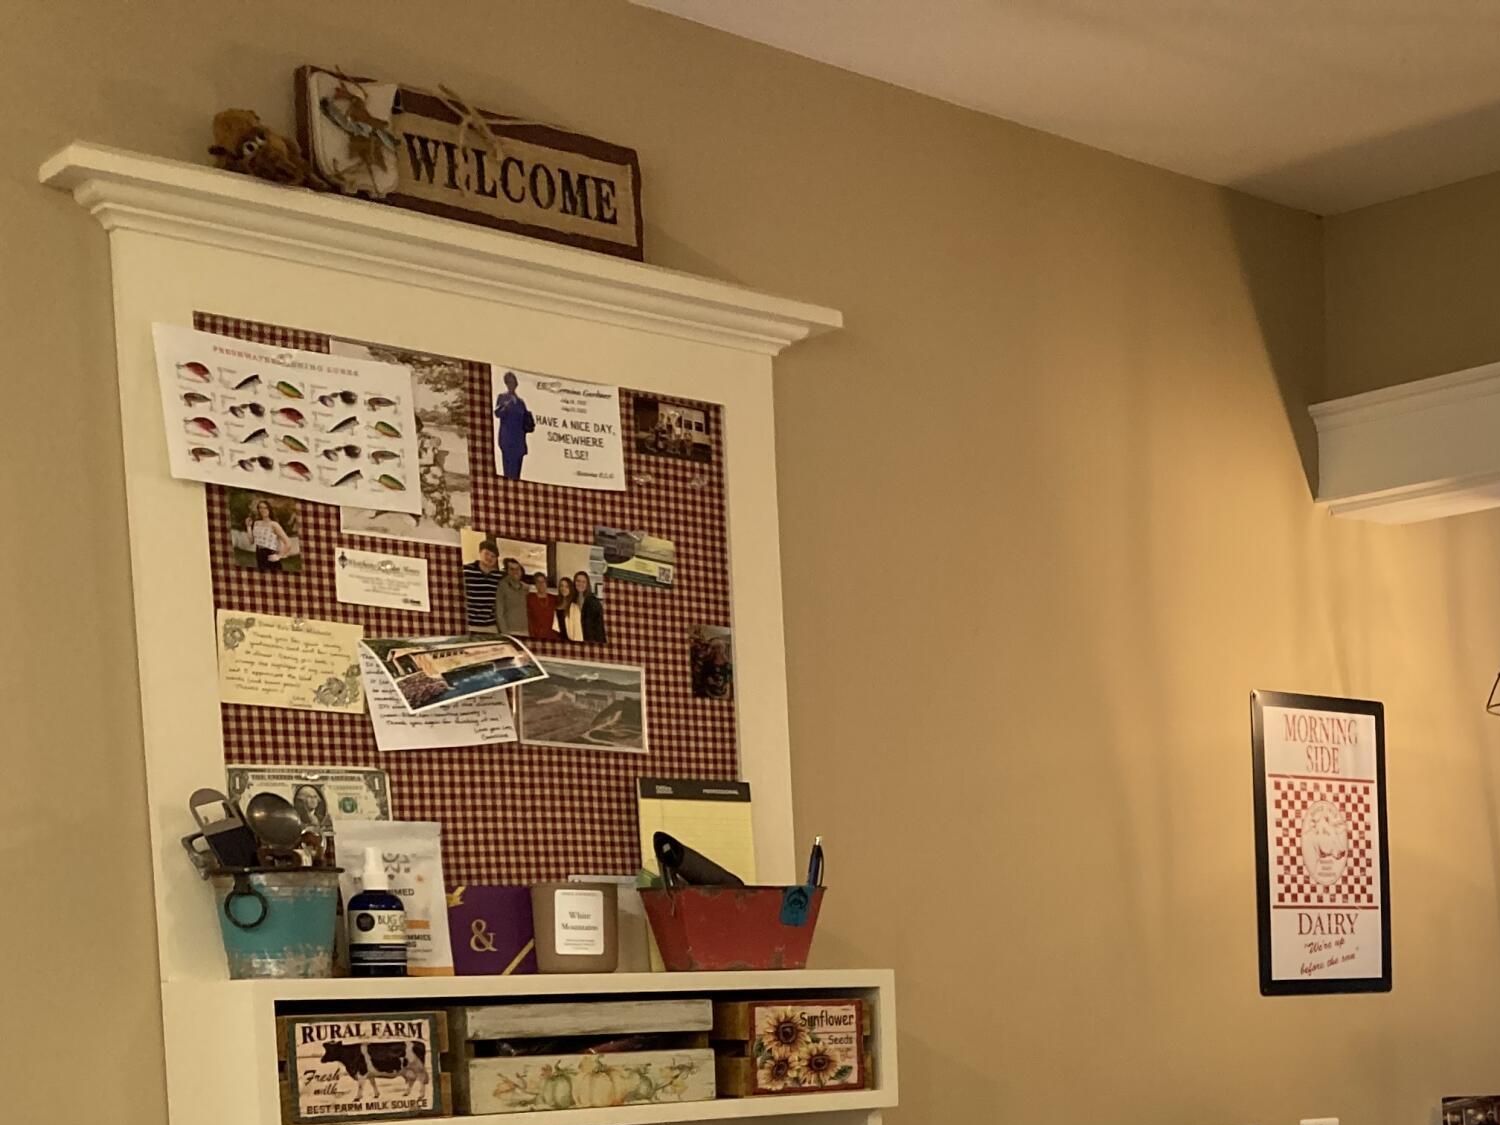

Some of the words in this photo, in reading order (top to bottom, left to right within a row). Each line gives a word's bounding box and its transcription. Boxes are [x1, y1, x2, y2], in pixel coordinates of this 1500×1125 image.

[402, 132, 618, 225] WELCOME
[535, 414, 559, 429] HAVE
[561, 418, 568, 430] A
[570, 420, 591, 433] NICE
[593, 423, 616, 436] DAY,
[547, 431, 605, 448] SOMEWHERE
[563, 448, 589, 461] ELSE!
[1284, 713, 1358, 745] MORNING
[1305, 744, 1340, 774] SIDE
[1297, 912, 1359, 936] DAIRY
[470, 918, 498, 952] &
[1300, 962, 1325, 977] before
[1327, 956, 1339, 968] the
[800, 1009, 854, 1028] Sunflower
[301, 1023, 366, 1045] RURAL
[371, 1021, 424, 1040] FARM
[827, 1034, 854, 1046] Seeds
[303, 1067, 341, 1086] Fresh
[306, 1104, 334, 1115] BEST
[335, 1103, 363, 1114] FARM
[366, 1101, 388, 1112] MILK
[391, 1098, 428, 1110] SOURCE
